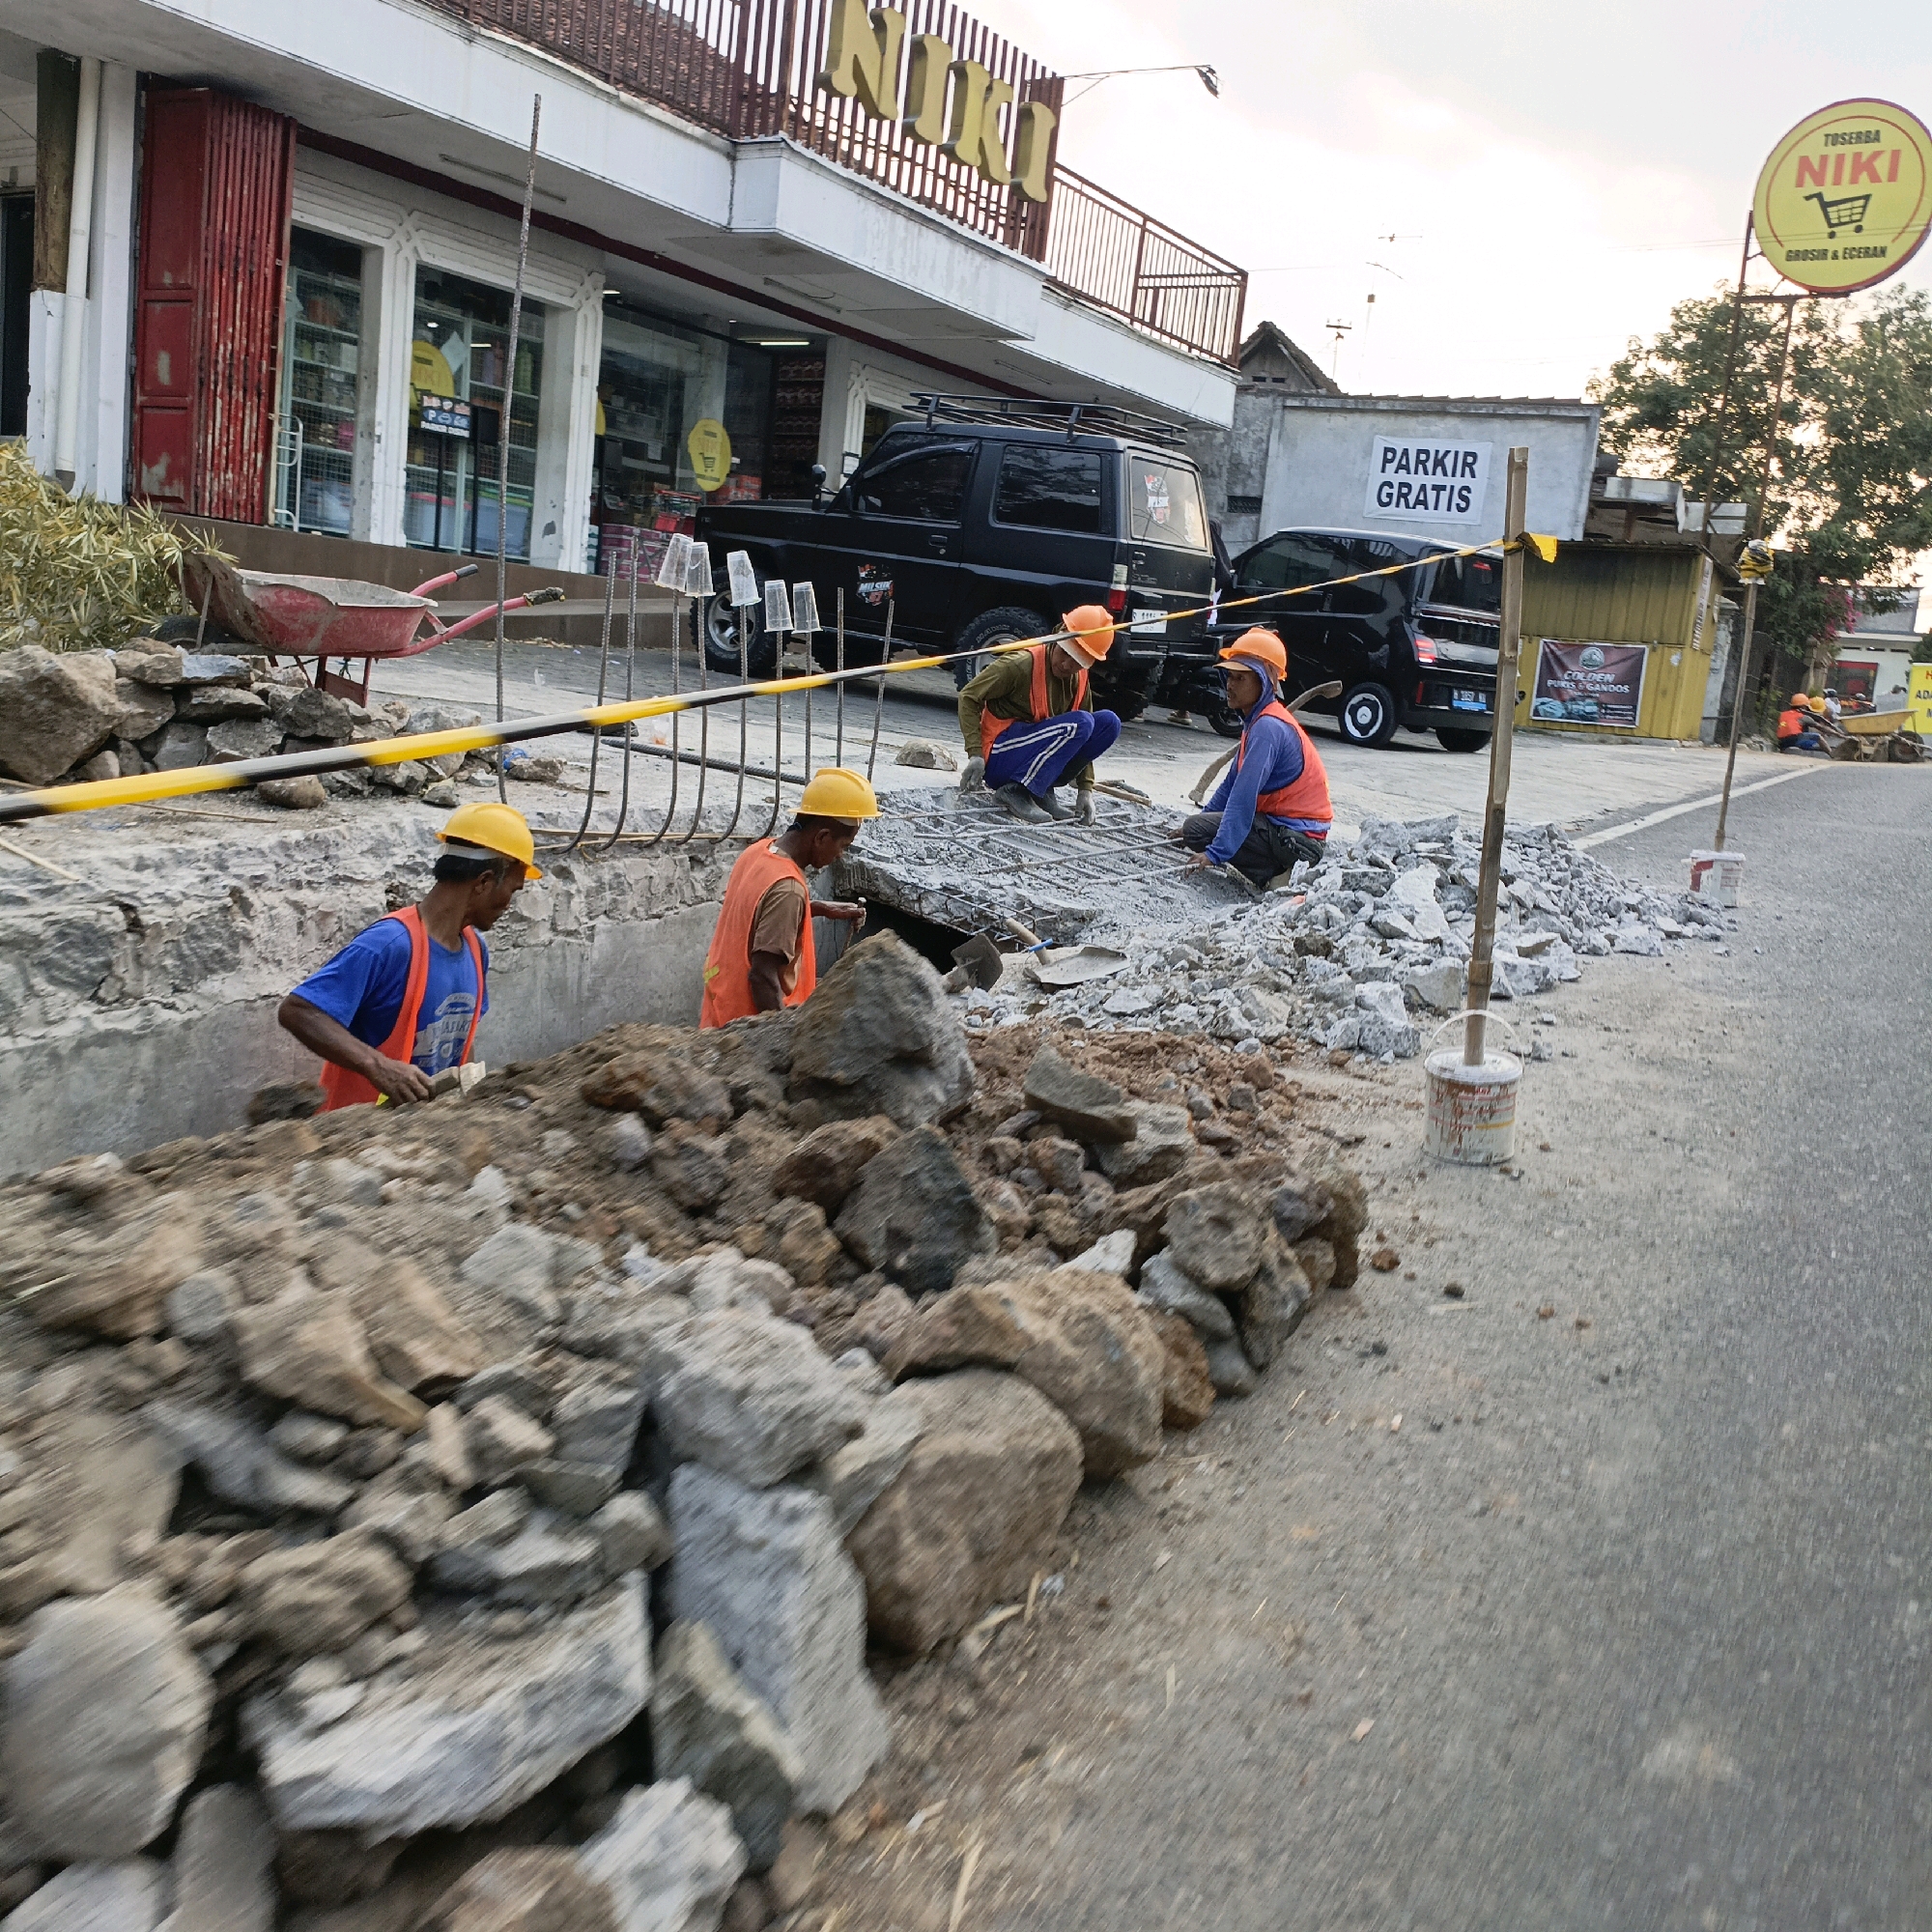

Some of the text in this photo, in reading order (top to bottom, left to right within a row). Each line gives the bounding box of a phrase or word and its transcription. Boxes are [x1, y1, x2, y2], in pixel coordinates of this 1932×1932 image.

[815, 0, 1056, 203] NIKI
[1824, 129, 1881, 147] TOSERBA
[1796, 149, 1901, 187] NIKI
[1785, 245, 1888, 262] GROSIR & ECERAN
[1380, 446, 1478, 478] PARKIR
[1377, 480, 1472, 513] GRATIS
[1564, 670, 1615, 683] GOLDEN
[1586, 682, 1631, 694] GANDOS
